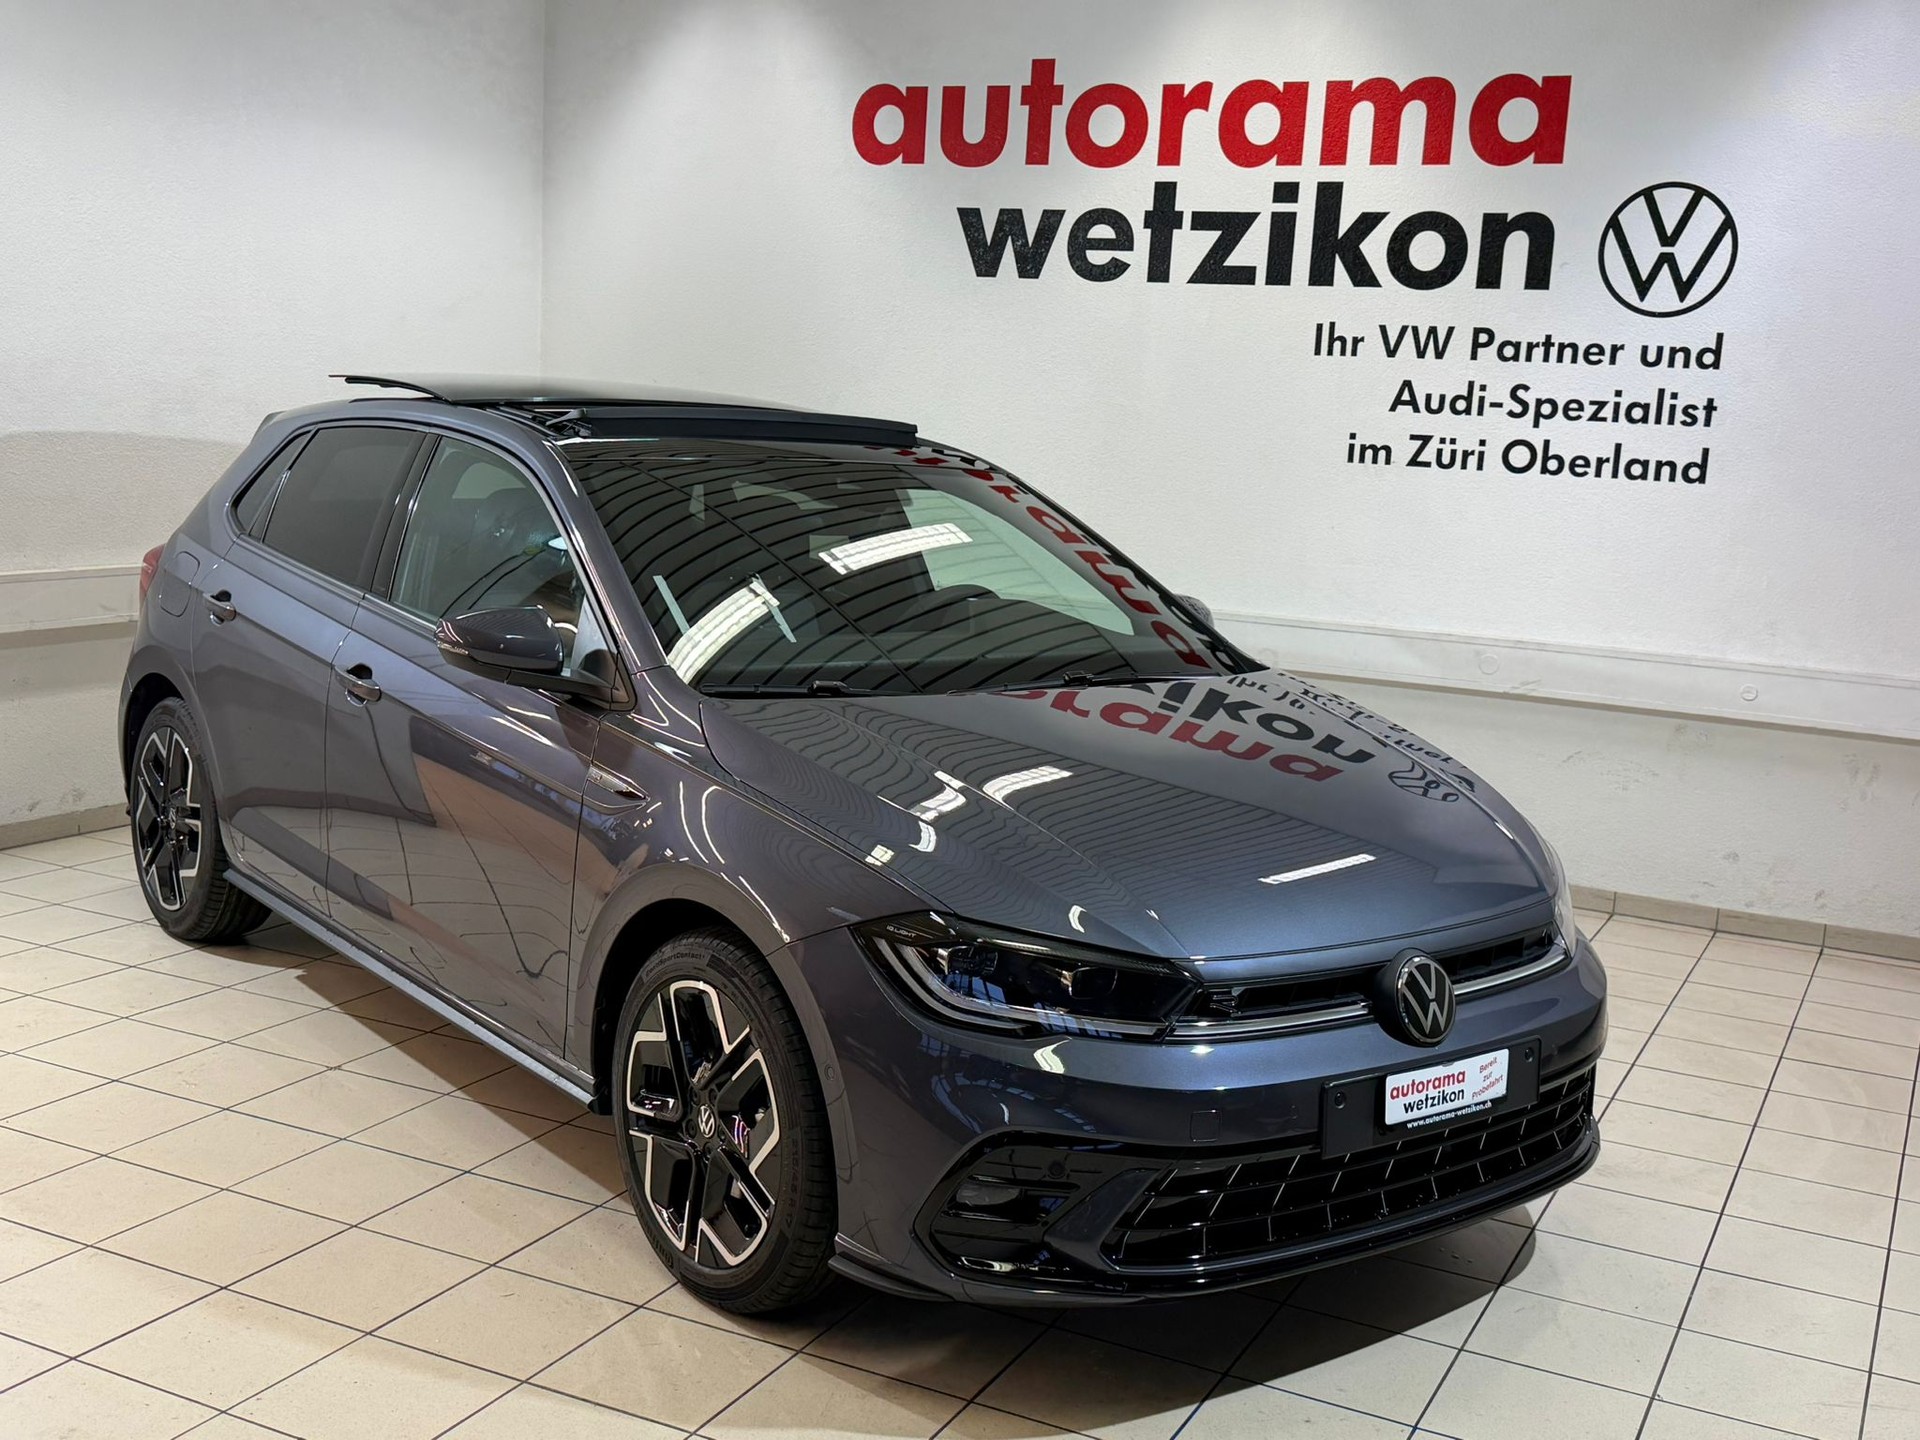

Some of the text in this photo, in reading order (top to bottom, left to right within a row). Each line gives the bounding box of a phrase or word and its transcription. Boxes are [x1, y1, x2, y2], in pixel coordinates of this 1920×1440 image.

[852, 58, 1573, 169] autorama
[956, 181, 1555, 291] wetzikon
[1314, 321, 1724, 371] Ihr VW Partner und
[1388, 379, 1719, 429] Audi-Spezialist
[1347, 432, 1710, 485] im Züri Oberland
[1479, 1057, 1498, 1073] Bereit
[1483, 1071, 1493, 1082] zur
[1389, 1069, 1466, 1100] autorama
[1471, 1074, 1504, 1101] Probefahrt
[1403, 1088, 1465, 1114] wetzikon
[1406, 1100, 1492, 1129] www.autorama-wetzikon.ch
